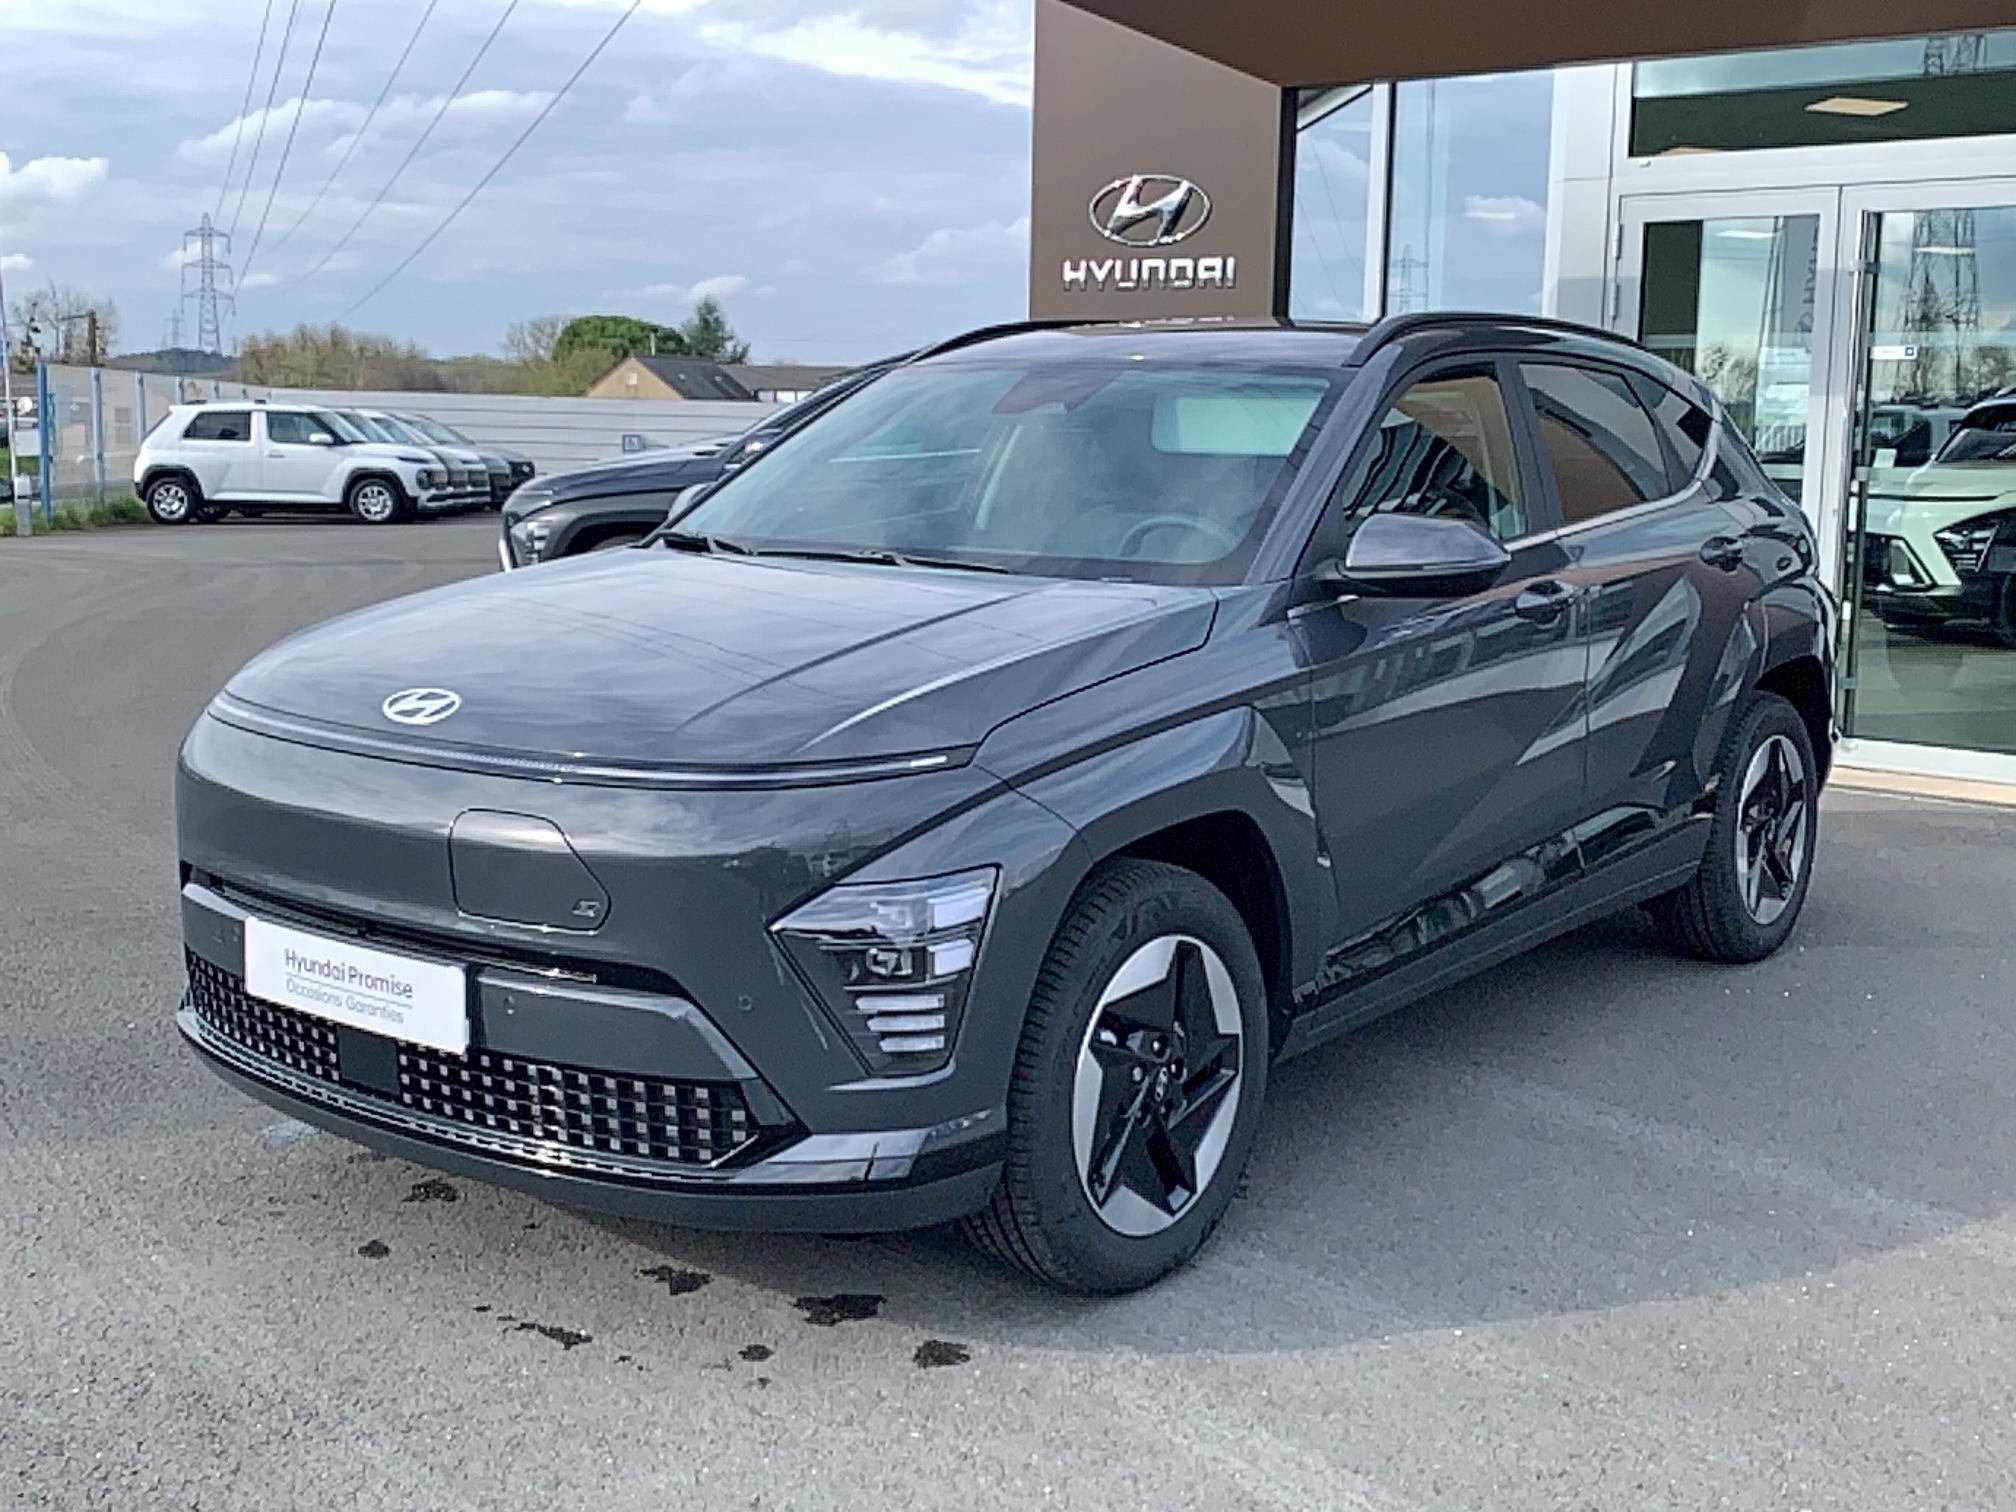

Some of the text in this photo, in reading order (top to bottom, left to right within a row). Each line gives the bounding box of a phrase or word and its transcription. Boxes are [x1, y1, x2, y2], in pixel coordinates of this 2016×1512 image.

[1062, 256, 1236, 291] HYUNDAI
[285, 948, 414, 999] Hyundai Promise
